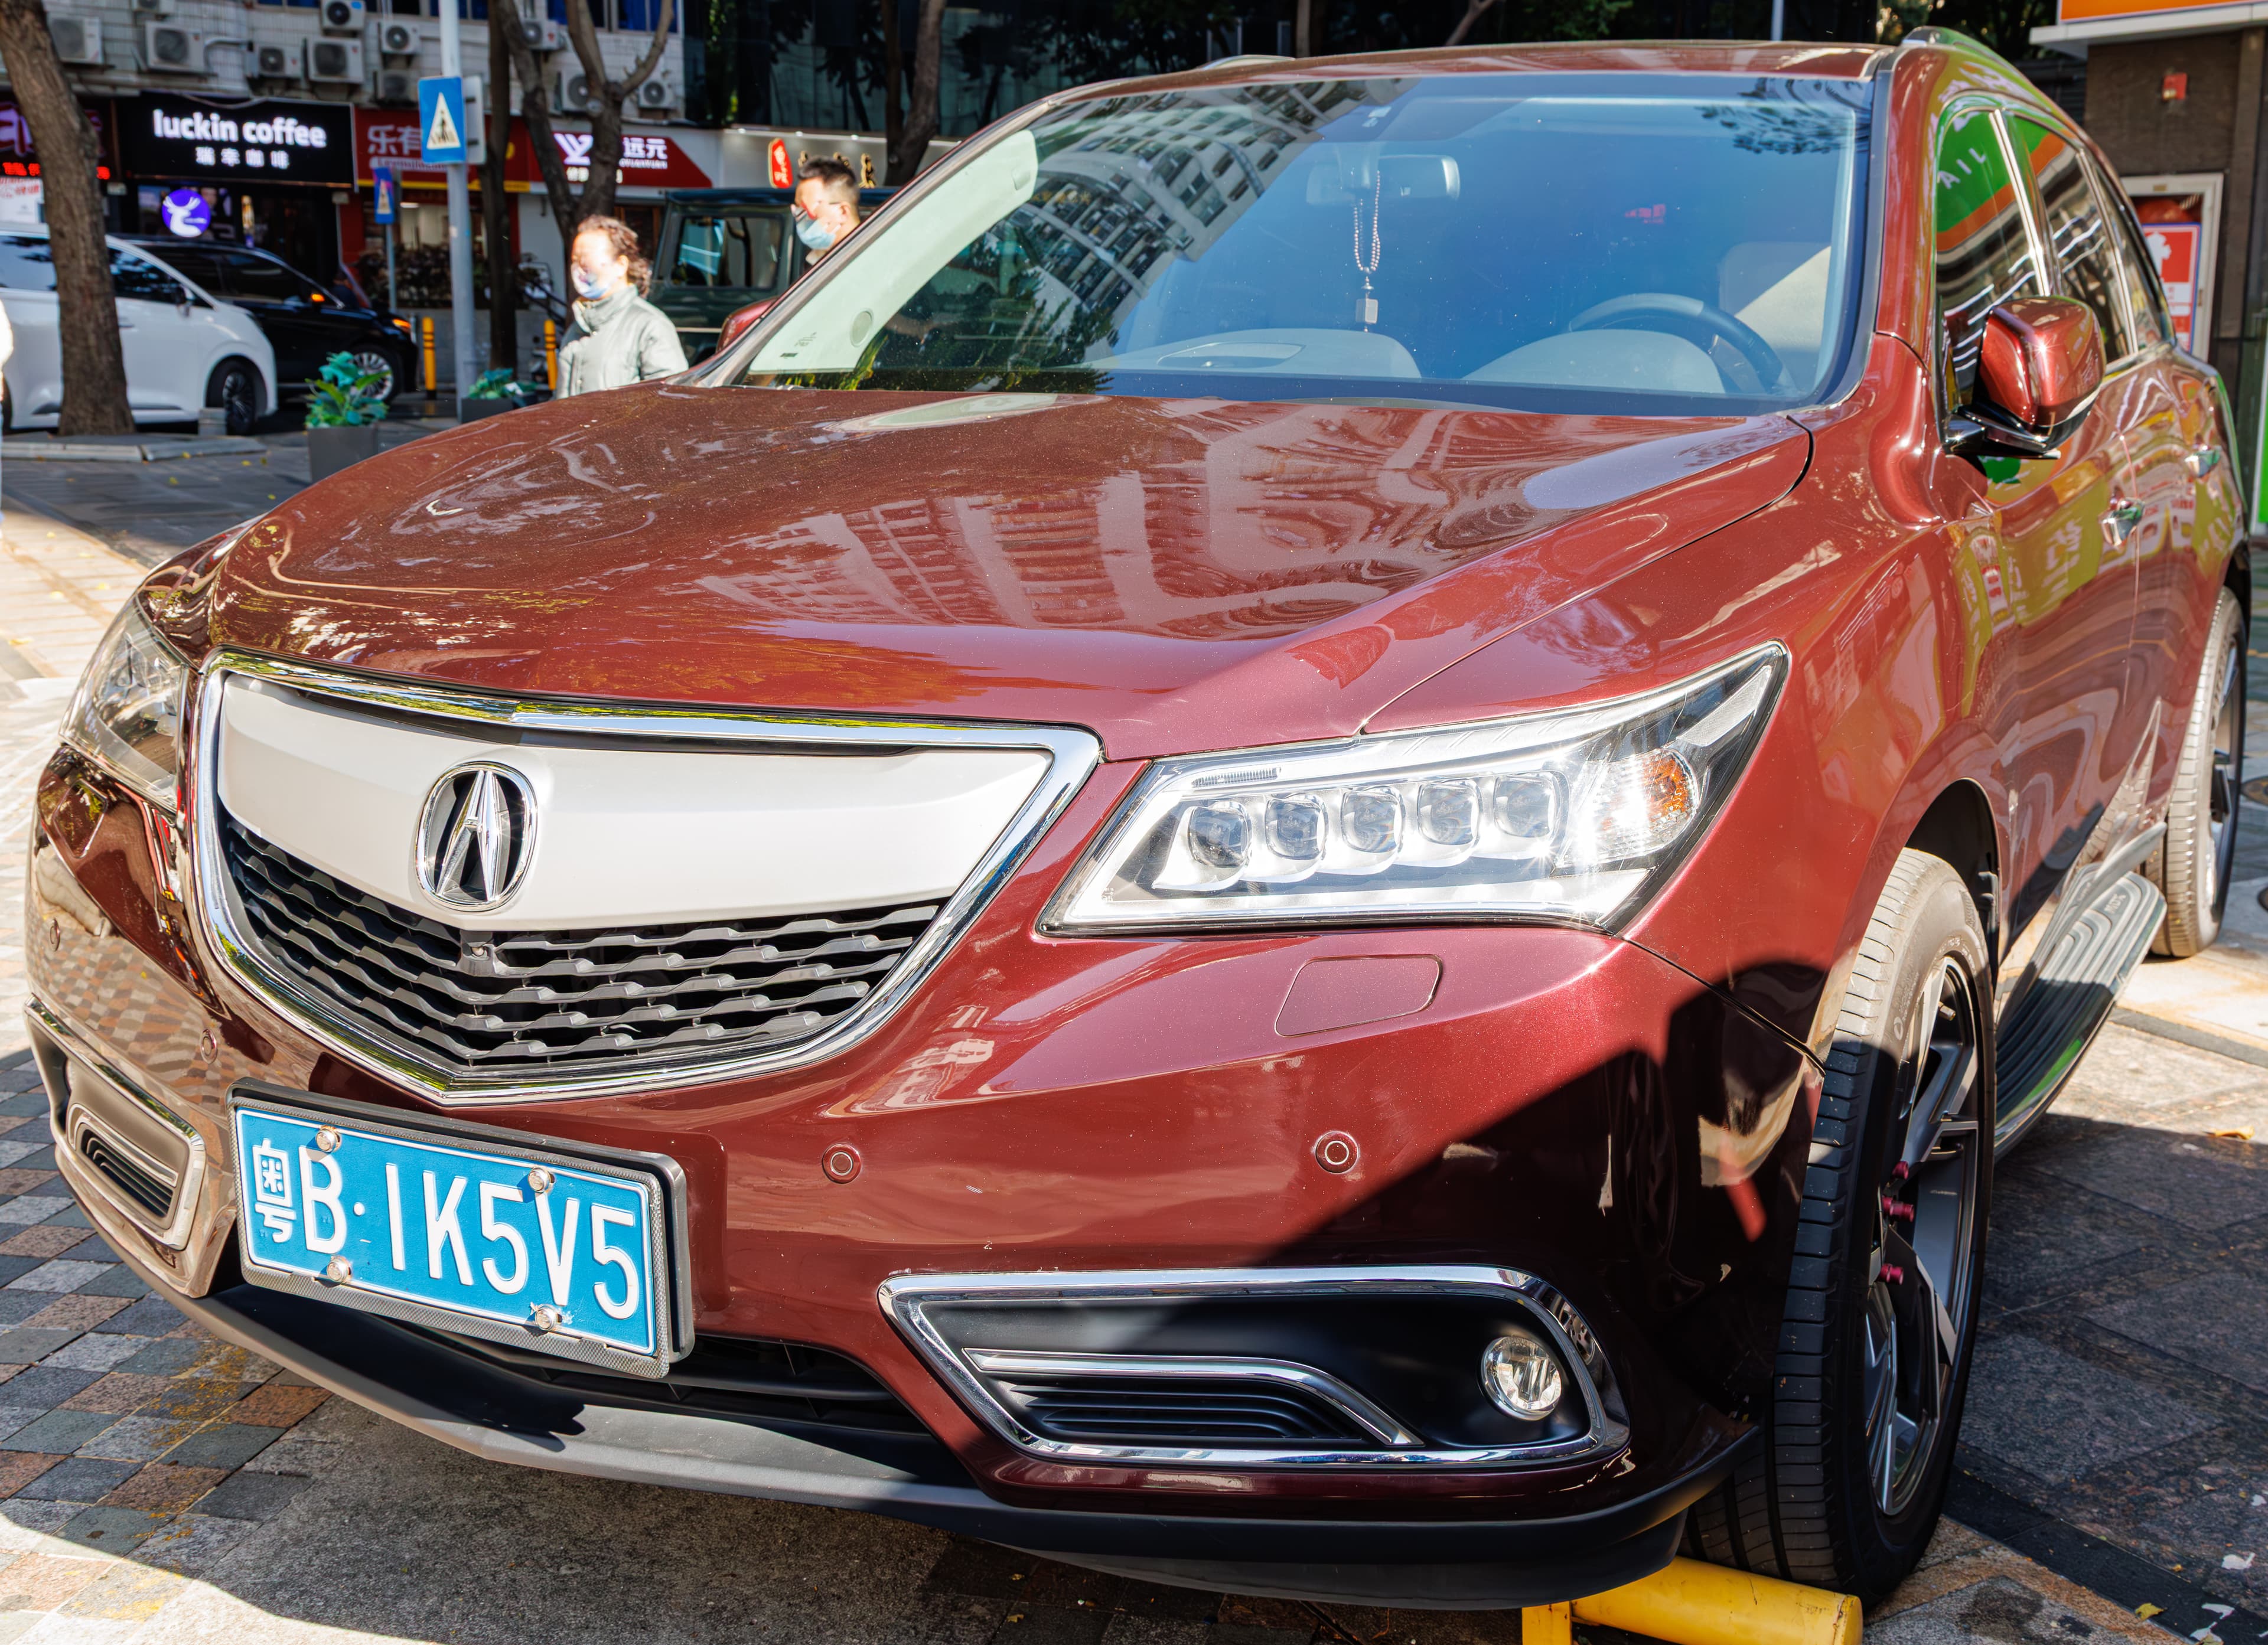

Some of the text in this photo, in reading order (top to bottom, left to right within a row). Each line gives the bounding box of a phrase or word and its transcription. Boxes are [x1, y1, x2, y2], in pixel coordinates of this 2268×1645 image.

[153, 109, 327, 148] luckin coffee
[252, 1138, 640, 1320] 粤B·1K5V5
